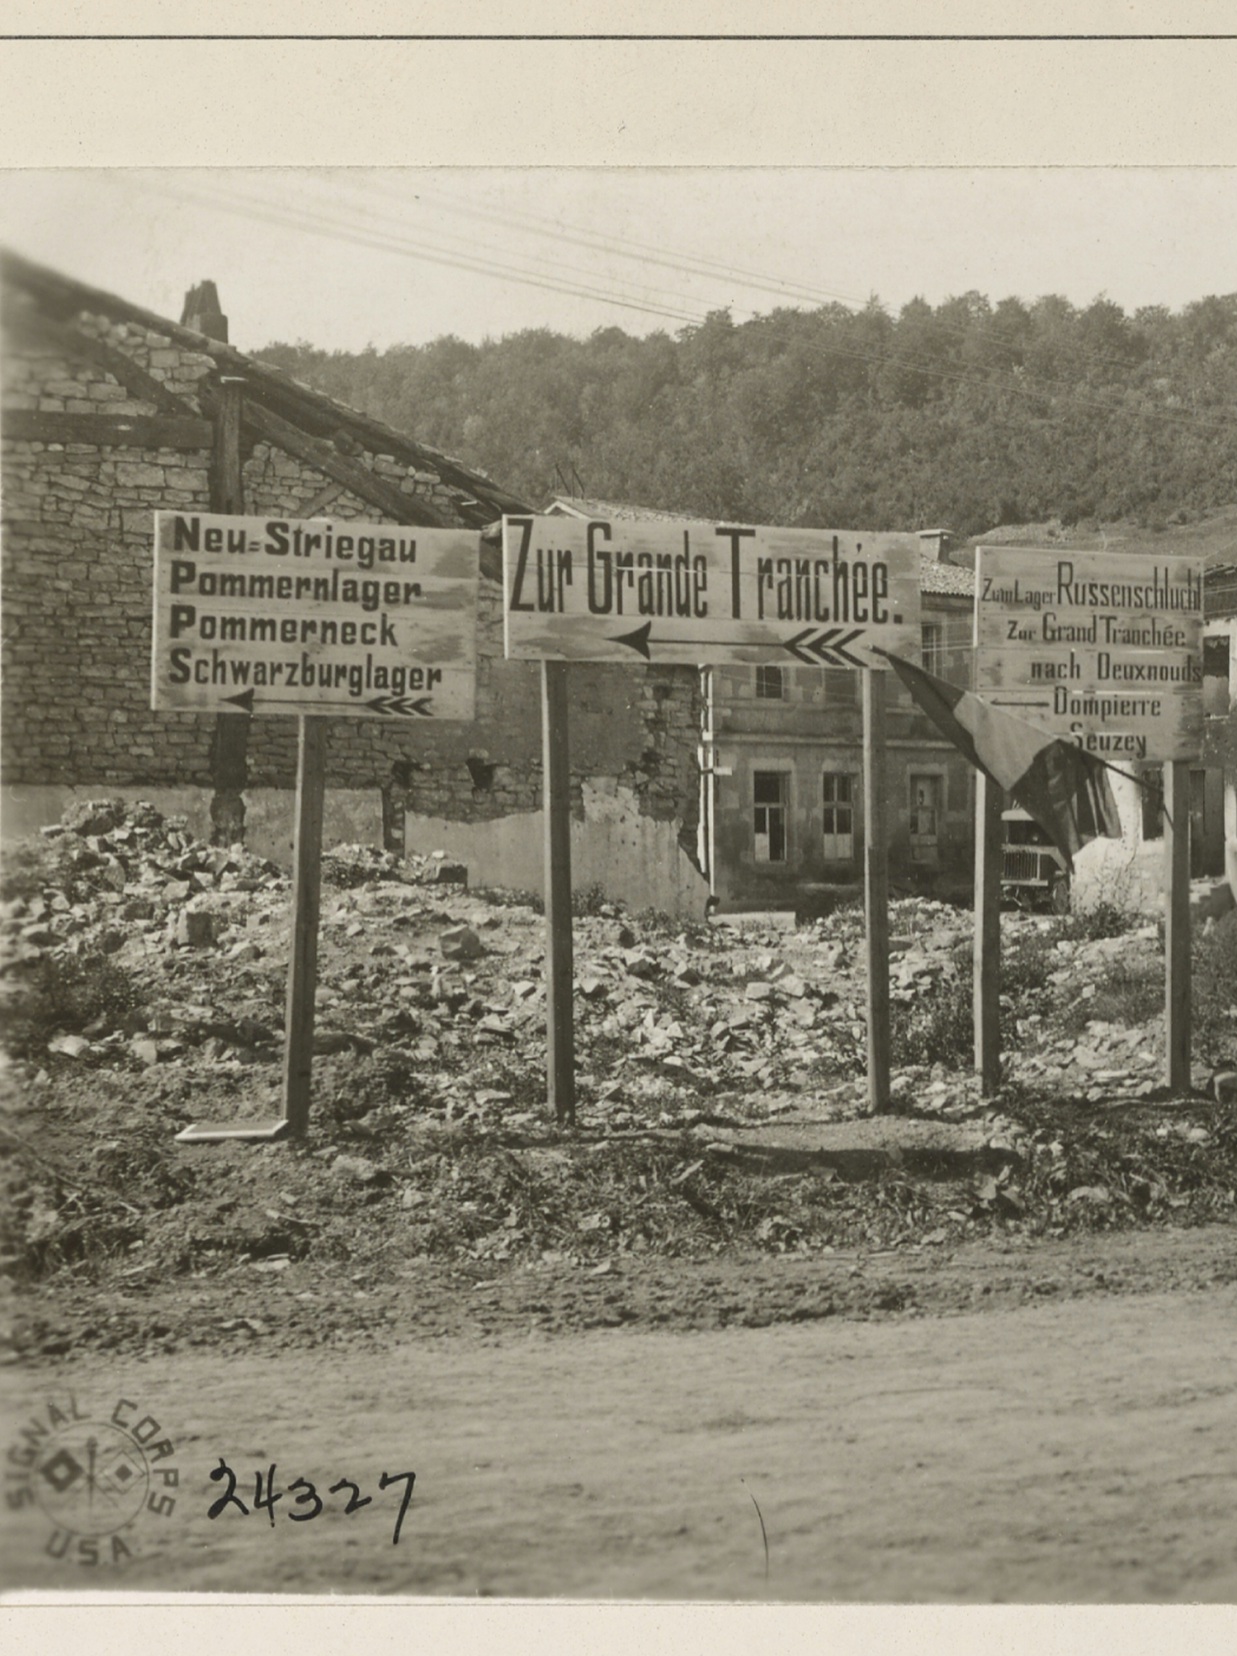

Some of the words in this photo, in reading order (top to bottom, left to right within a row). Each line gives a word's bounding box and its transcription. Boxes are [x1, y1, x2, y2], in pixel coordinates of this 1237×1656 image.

[170, 560, 421, 612] Pommernlager
[508, 518, 574, 612] Zur
[587, 521, 708, 619] Grande
[715, 527, 903, 625] Tranchée.
[1014, 579, 1056, 611] Lager
[170, 604, 399, 647] Pommerneck
[1006, 619, 1036, 641] Zur
[1042, 611, 1097, 645] Grand
[1099, 615, 1187, 647] Tranchée
[168, 648, 443, 698] Schwarzburglager
[1031, 652, 1081, 681] nach
[1097, 653, 1201, 684] Deuxnouds
[1053, 686, 1161, 722] Dompierre
[1070, 722, 1147, 760] Seuzey
